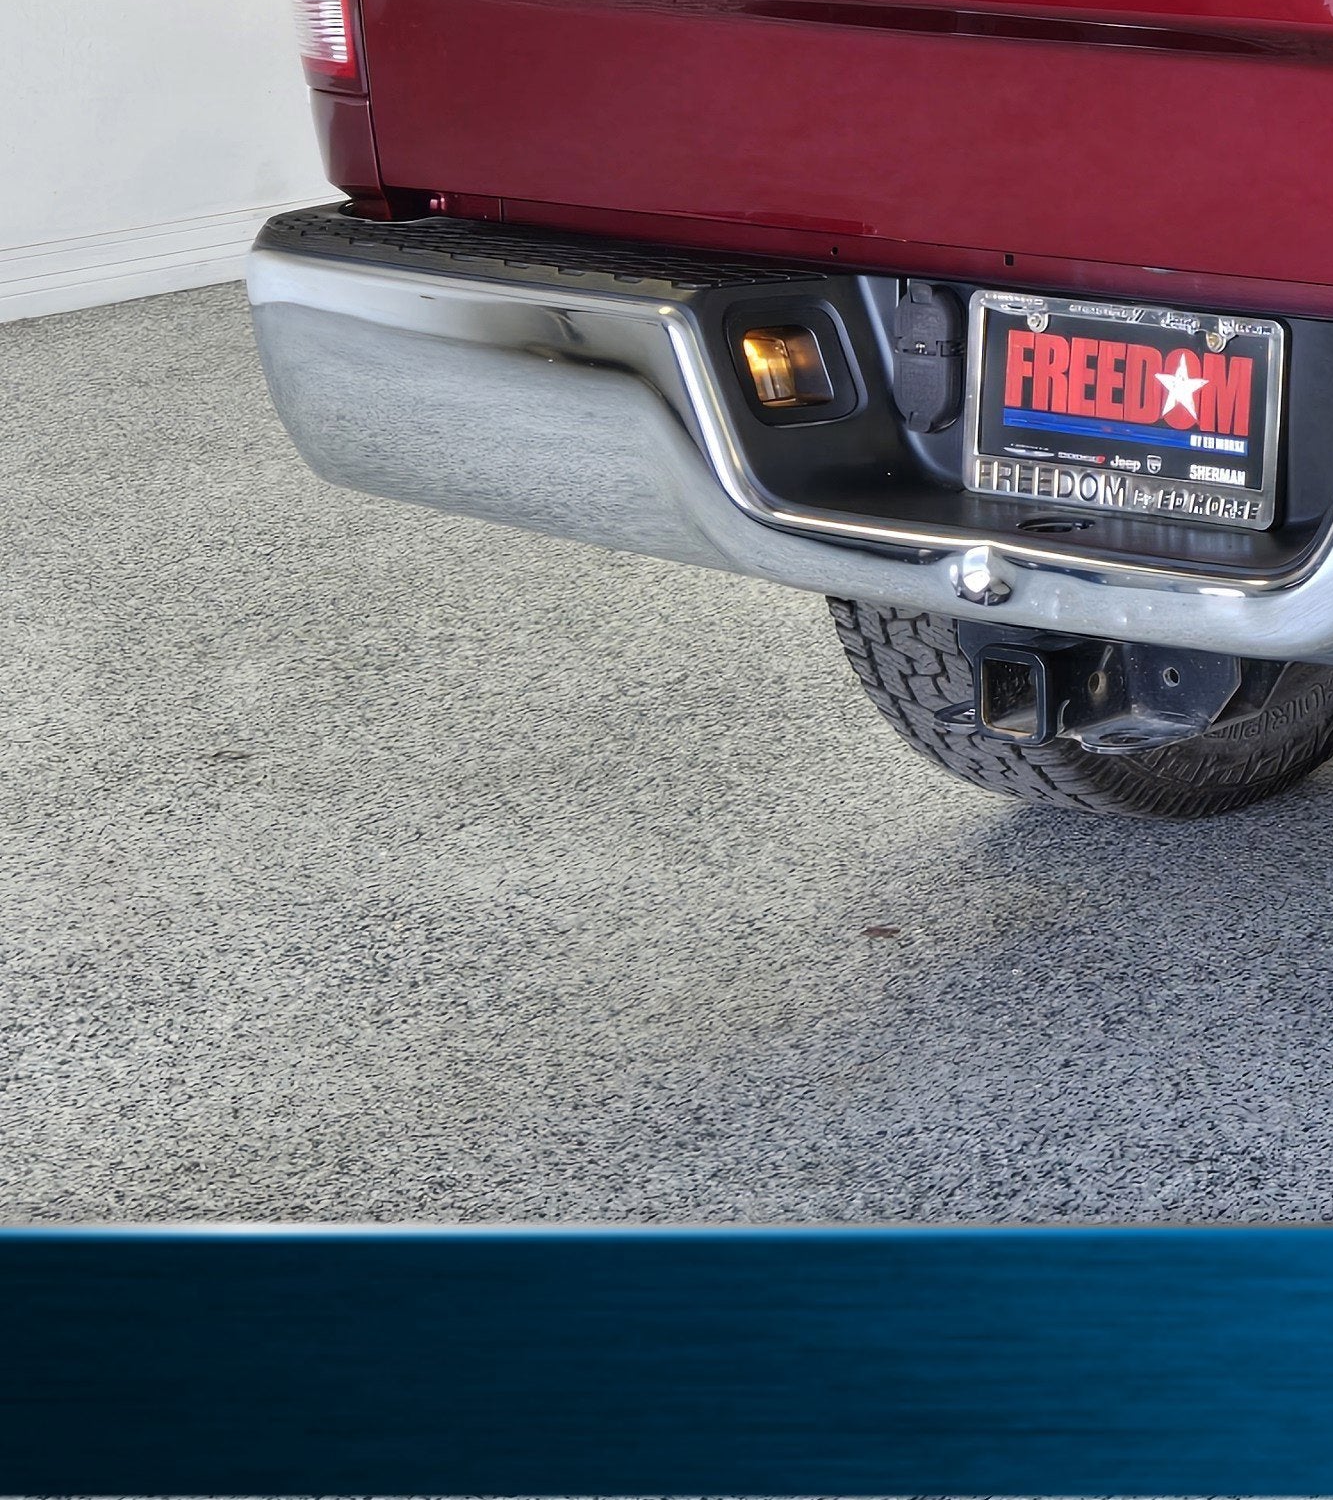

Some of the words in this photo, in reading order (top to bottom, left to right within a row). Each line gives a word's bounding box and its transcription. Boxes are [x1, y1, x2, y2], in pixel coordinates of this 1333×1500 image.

[1110, 454, 1142, 473] Jeep
[974, 458, 1129, 507] FREEDOM
[1189, 464, 1246, 486] SHERMAN
